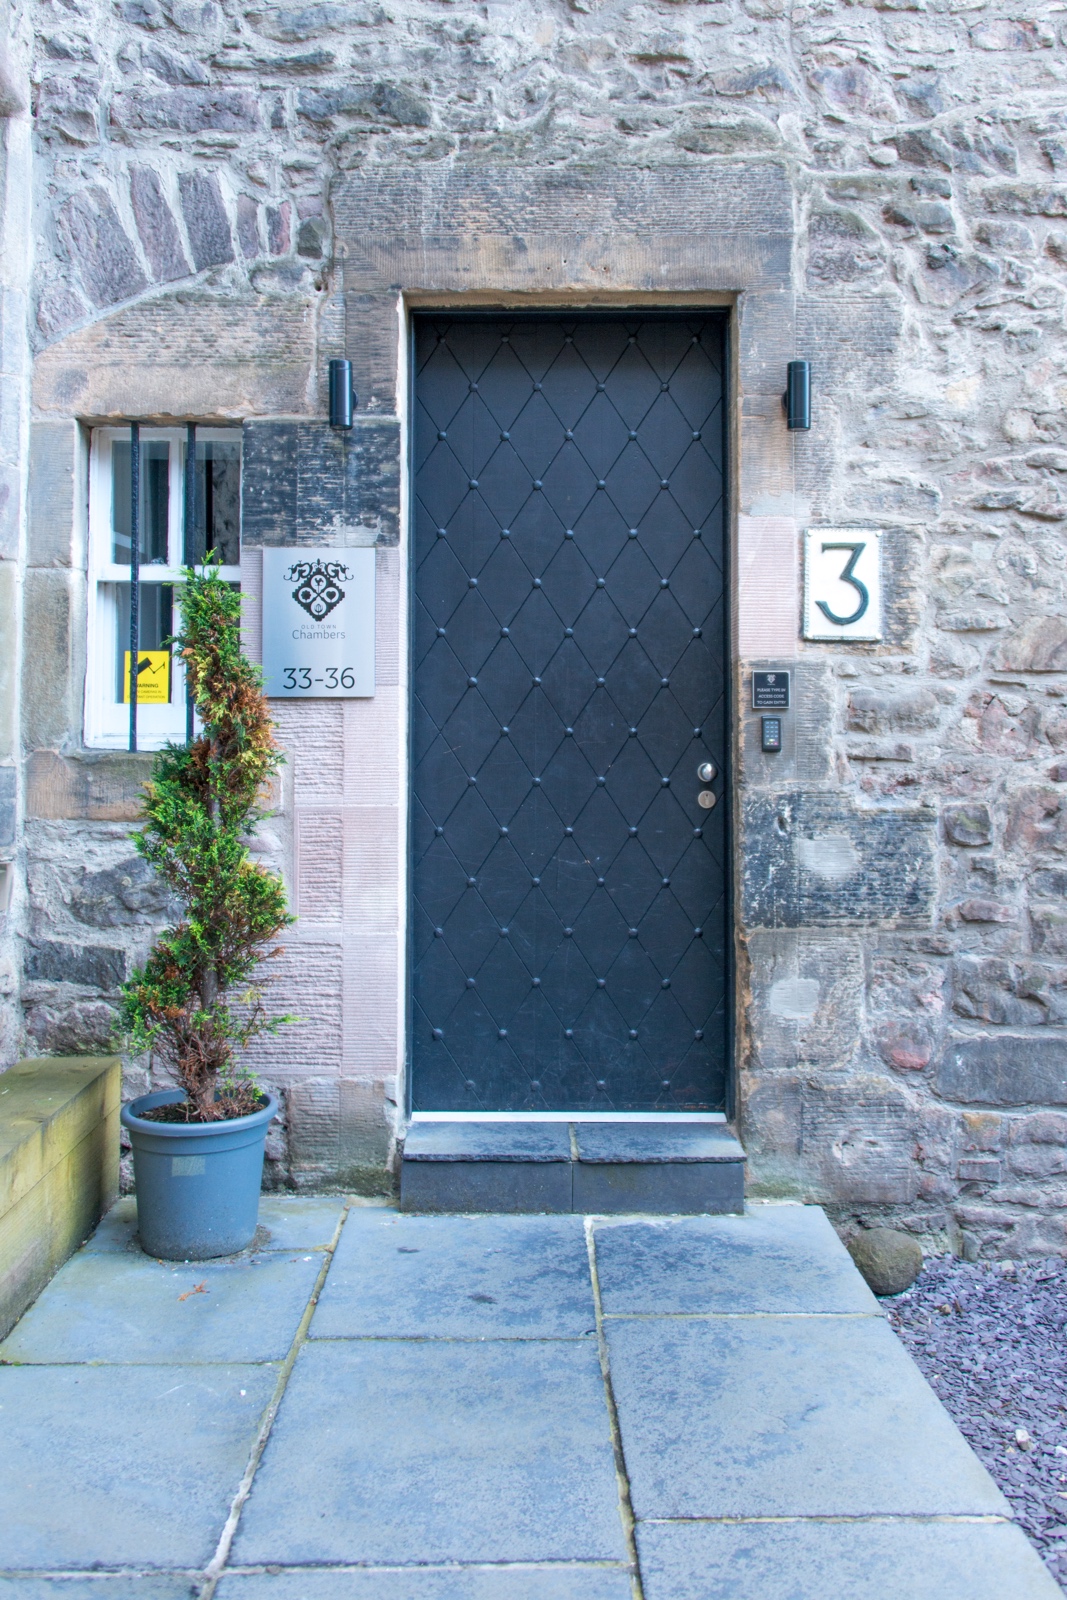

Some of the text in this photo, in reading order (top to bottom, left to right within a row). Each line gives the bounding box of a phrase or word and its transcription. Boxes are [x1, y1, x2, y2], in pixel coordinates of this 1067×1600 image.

[814, 542, 869, 626] 3
[292, 629, 346, 639] Chambers
[283, 667, 355, 689] 33-36
